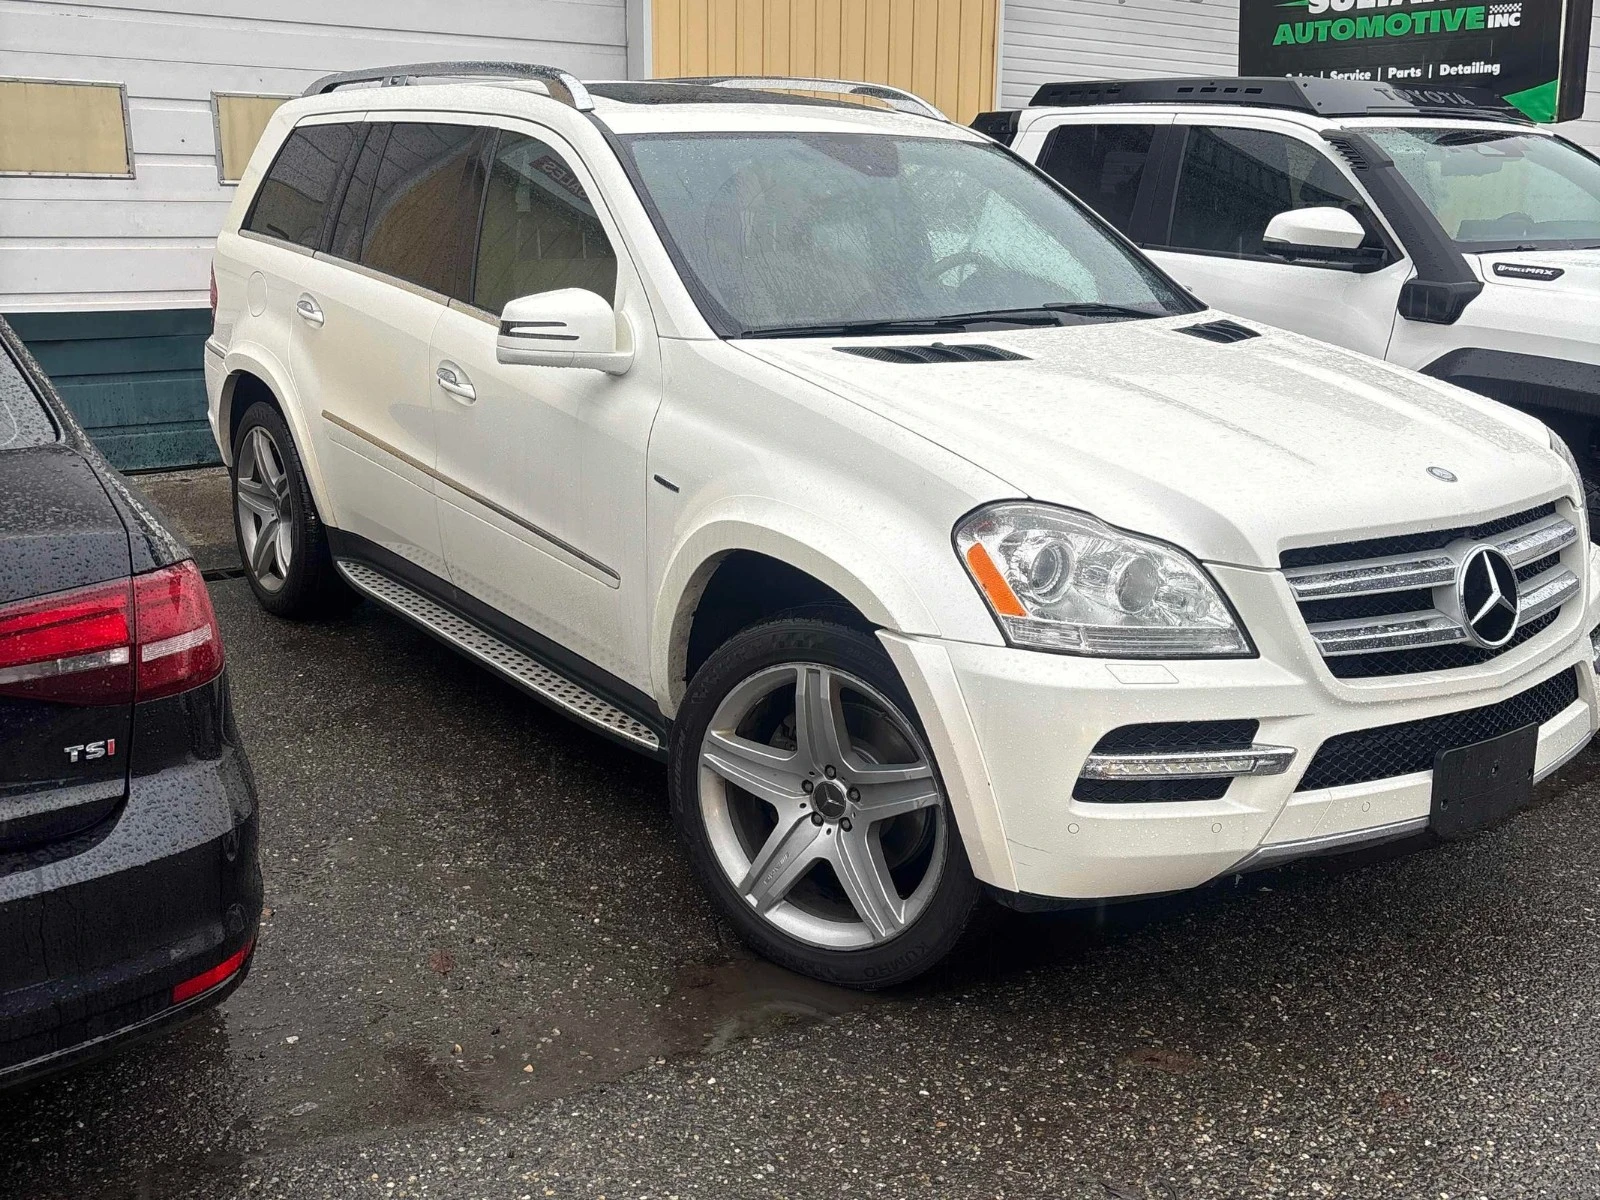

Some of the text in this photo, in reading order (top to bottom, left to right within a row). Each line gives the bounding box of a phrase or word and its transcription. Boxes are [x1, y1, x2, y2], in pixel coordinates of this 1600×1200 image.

[1272, 6, 1485, 46] AUTOMOTIVE
[1487, 12, 1522, 29] INC
[1330, 61, 1501, 80] Service Parts Detailing
[1373, 87, 1476, 106] TOYOTA
[63, 739, 116, 763] TSI
[863, 941, 929, 978] KUMHO
